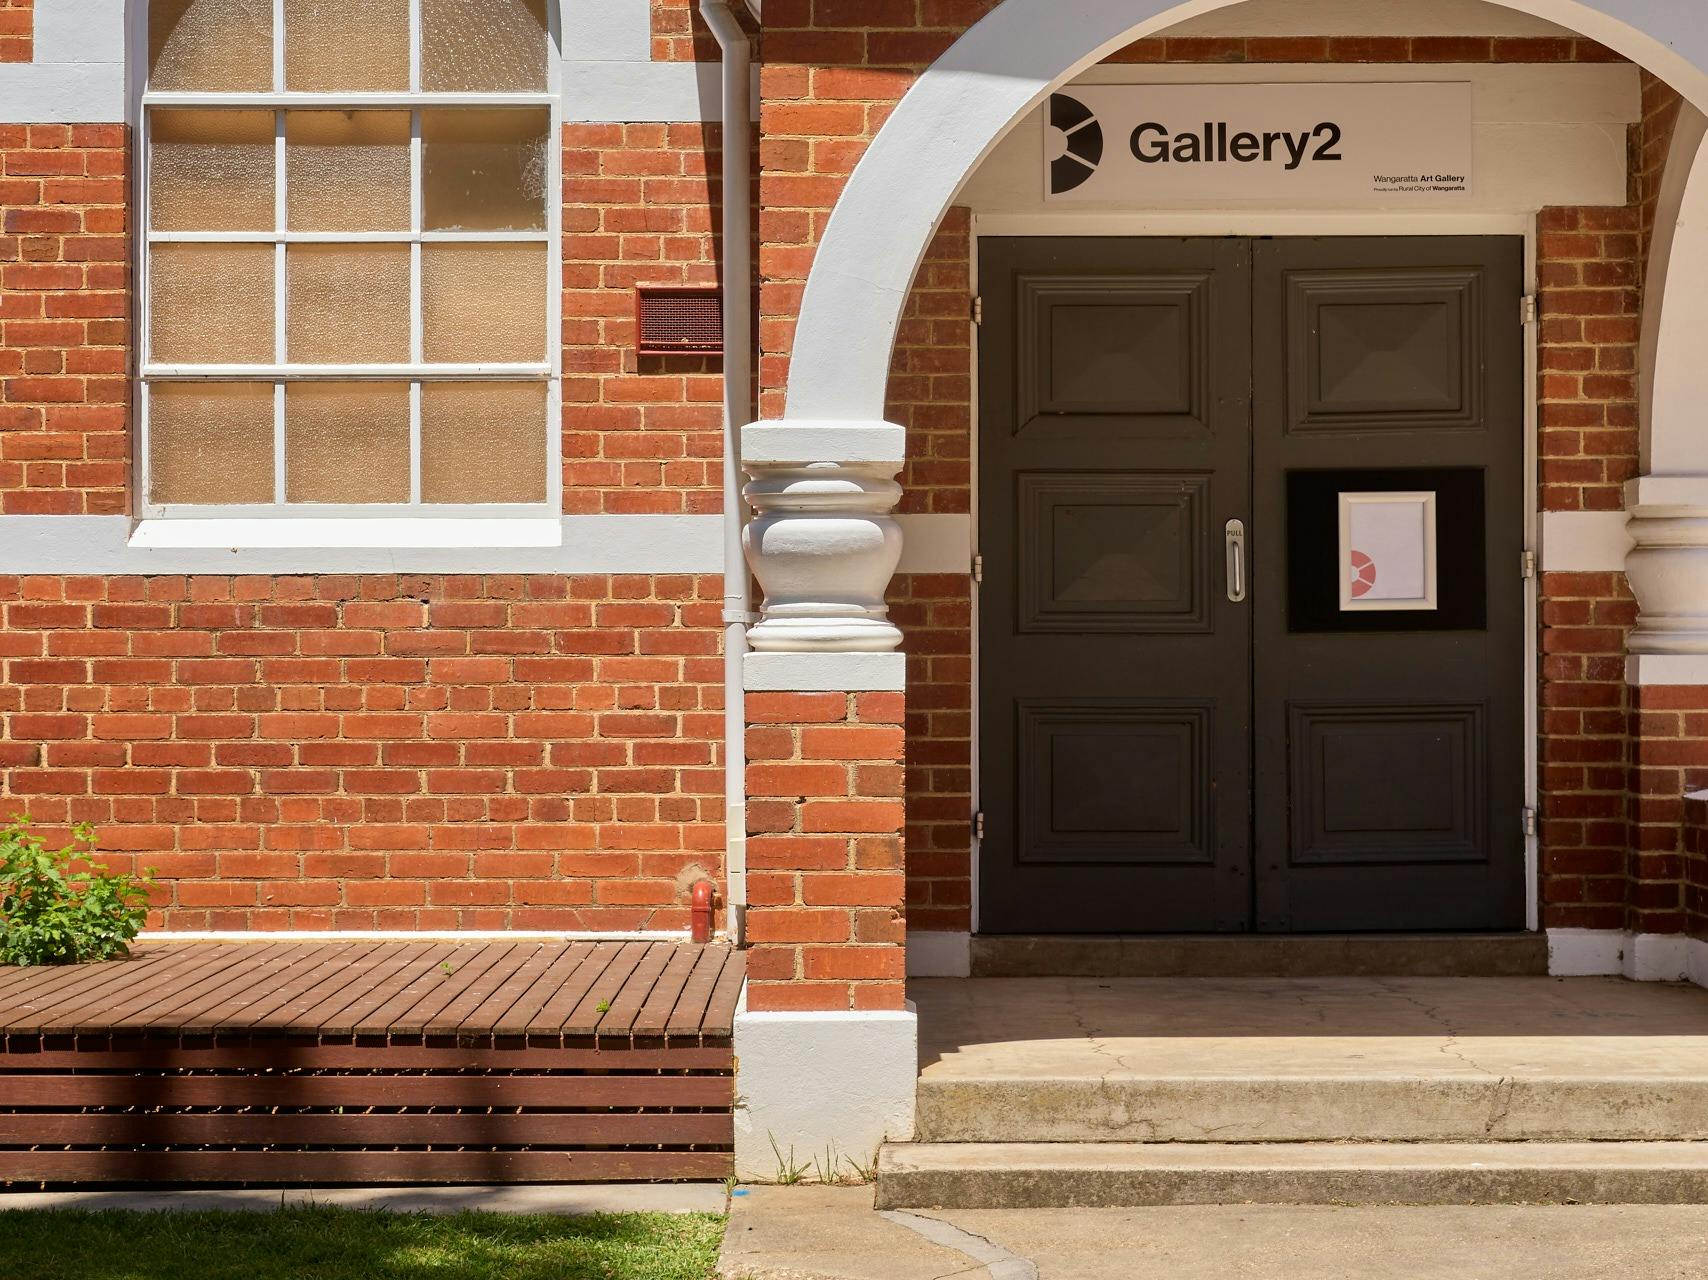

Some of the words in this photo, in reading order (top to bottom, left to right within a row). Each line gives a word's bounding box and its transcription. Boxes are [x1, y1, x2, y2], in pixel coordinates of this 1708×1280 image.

[1130, 121, 1342, 170] Gallery2
[1373, 175, 1418, 183] Wangaratta
[1435, 174, 1465, 183] Gallery
